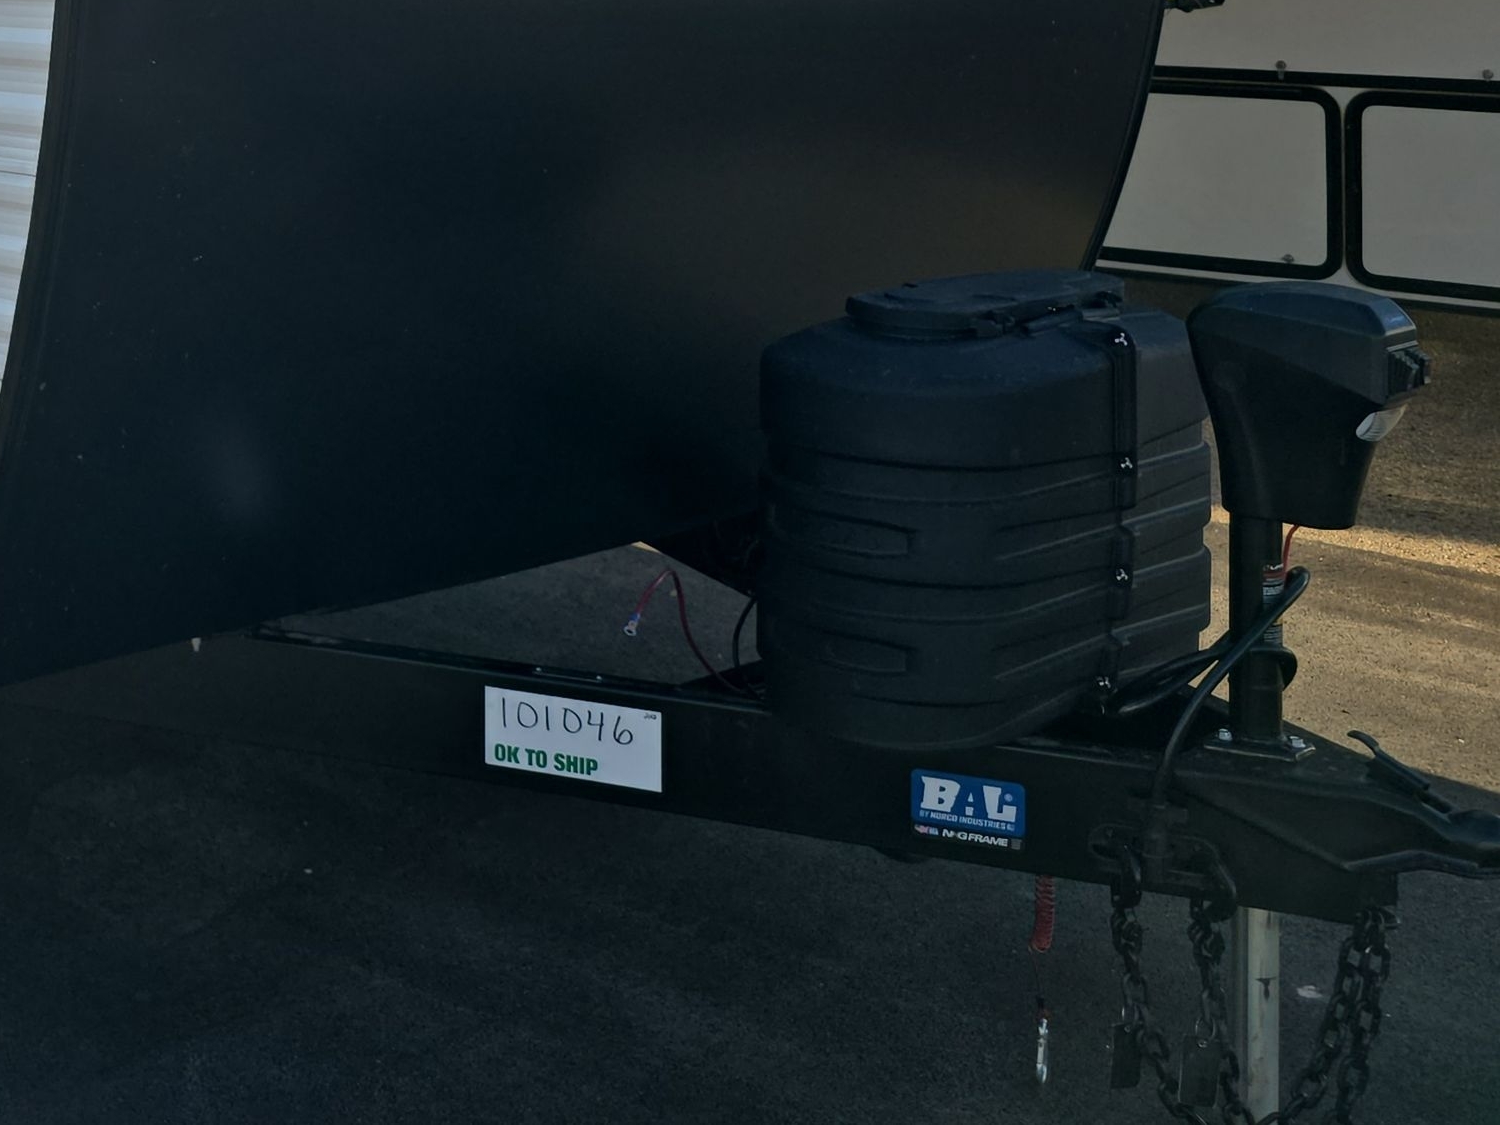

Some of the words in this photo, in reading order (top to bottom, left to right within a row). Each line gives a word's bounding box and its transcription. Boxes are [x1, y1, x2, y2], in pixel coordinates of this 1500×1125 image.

[501, 696, 634, 746] 101046
[494, 742, 520, 765] OK
[525, 747, 548, 769] TO
[553, 752, 599, 776] SHIP
[919, 809, 930, 818] BY
[930, 811, 958, 823] NORCO
[959, 816, 1006, 830] INDUSTRIES
[920, 775, 1018, 823] BAL
